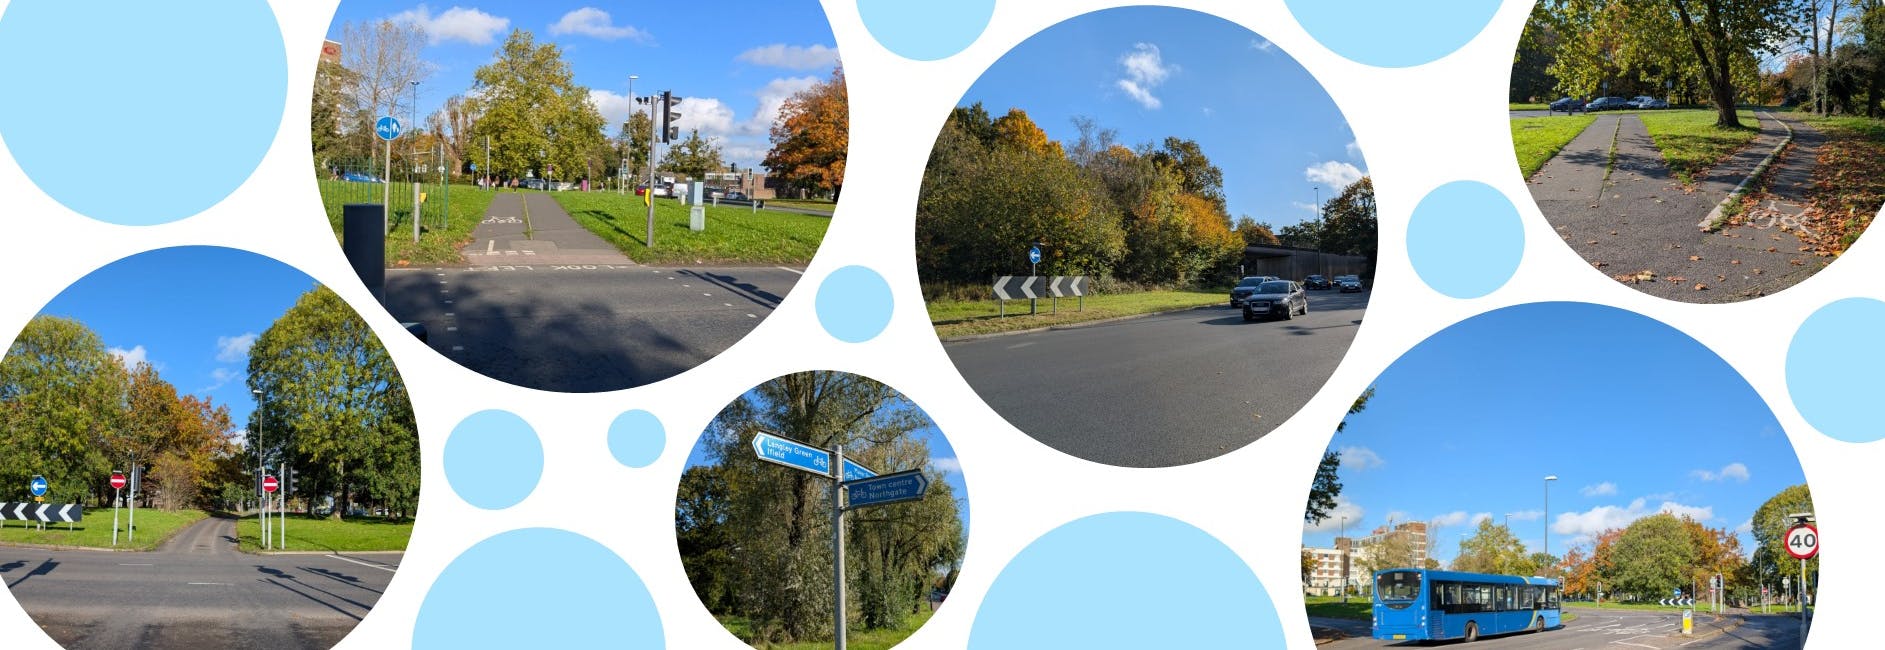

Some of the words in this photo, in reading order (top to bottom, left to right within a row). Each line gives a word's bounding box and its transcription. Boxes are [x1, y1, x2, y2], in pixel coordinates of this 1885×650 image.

[767, 439, 793, 454] Langley
[794, 447, 813, 458] Green
[868, 483, 887, 491] Town
[888, 479, 913, 488] centre
[868, 488, 908, 500] Northgate
[1790, 533, 1816, 548] 40
